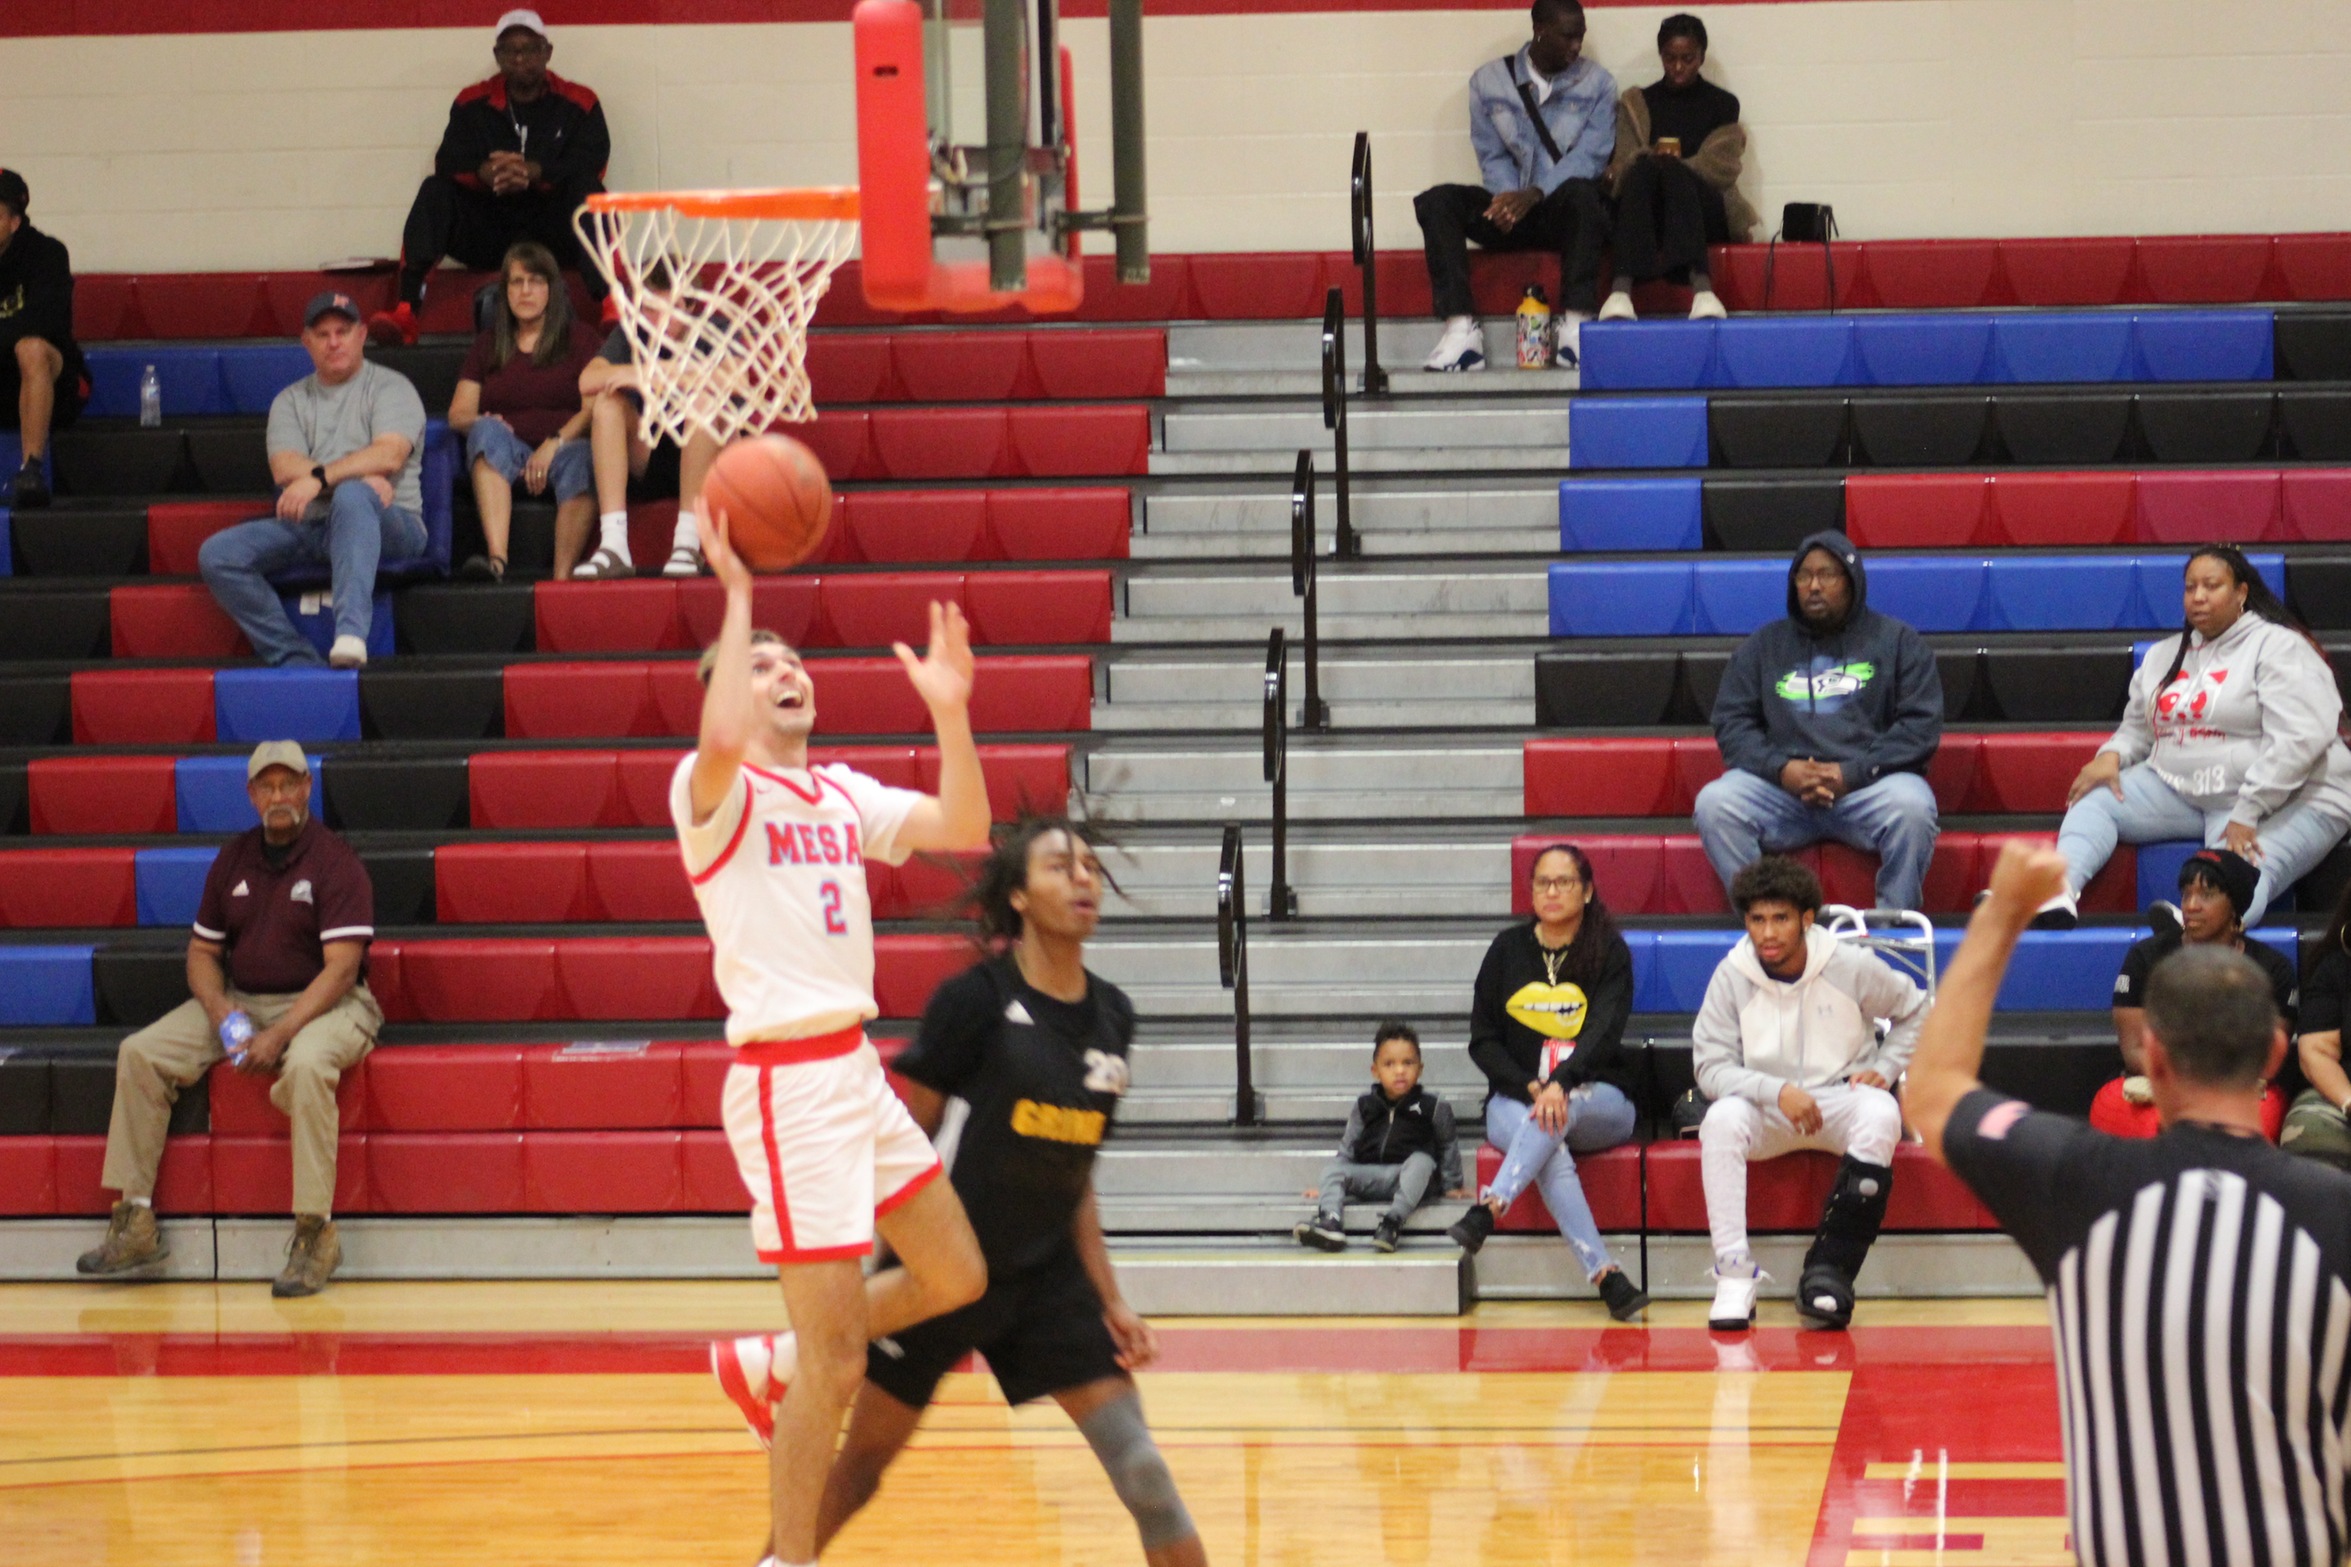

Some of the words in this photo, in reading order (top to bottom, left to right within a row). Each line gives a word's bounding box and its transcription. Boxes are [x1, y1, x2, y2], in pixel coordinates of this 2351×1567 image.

[2192, 764, 2226, 796] 313
[764, 821, 864, 866] MESA
[819, 879, 848, 936] 2
